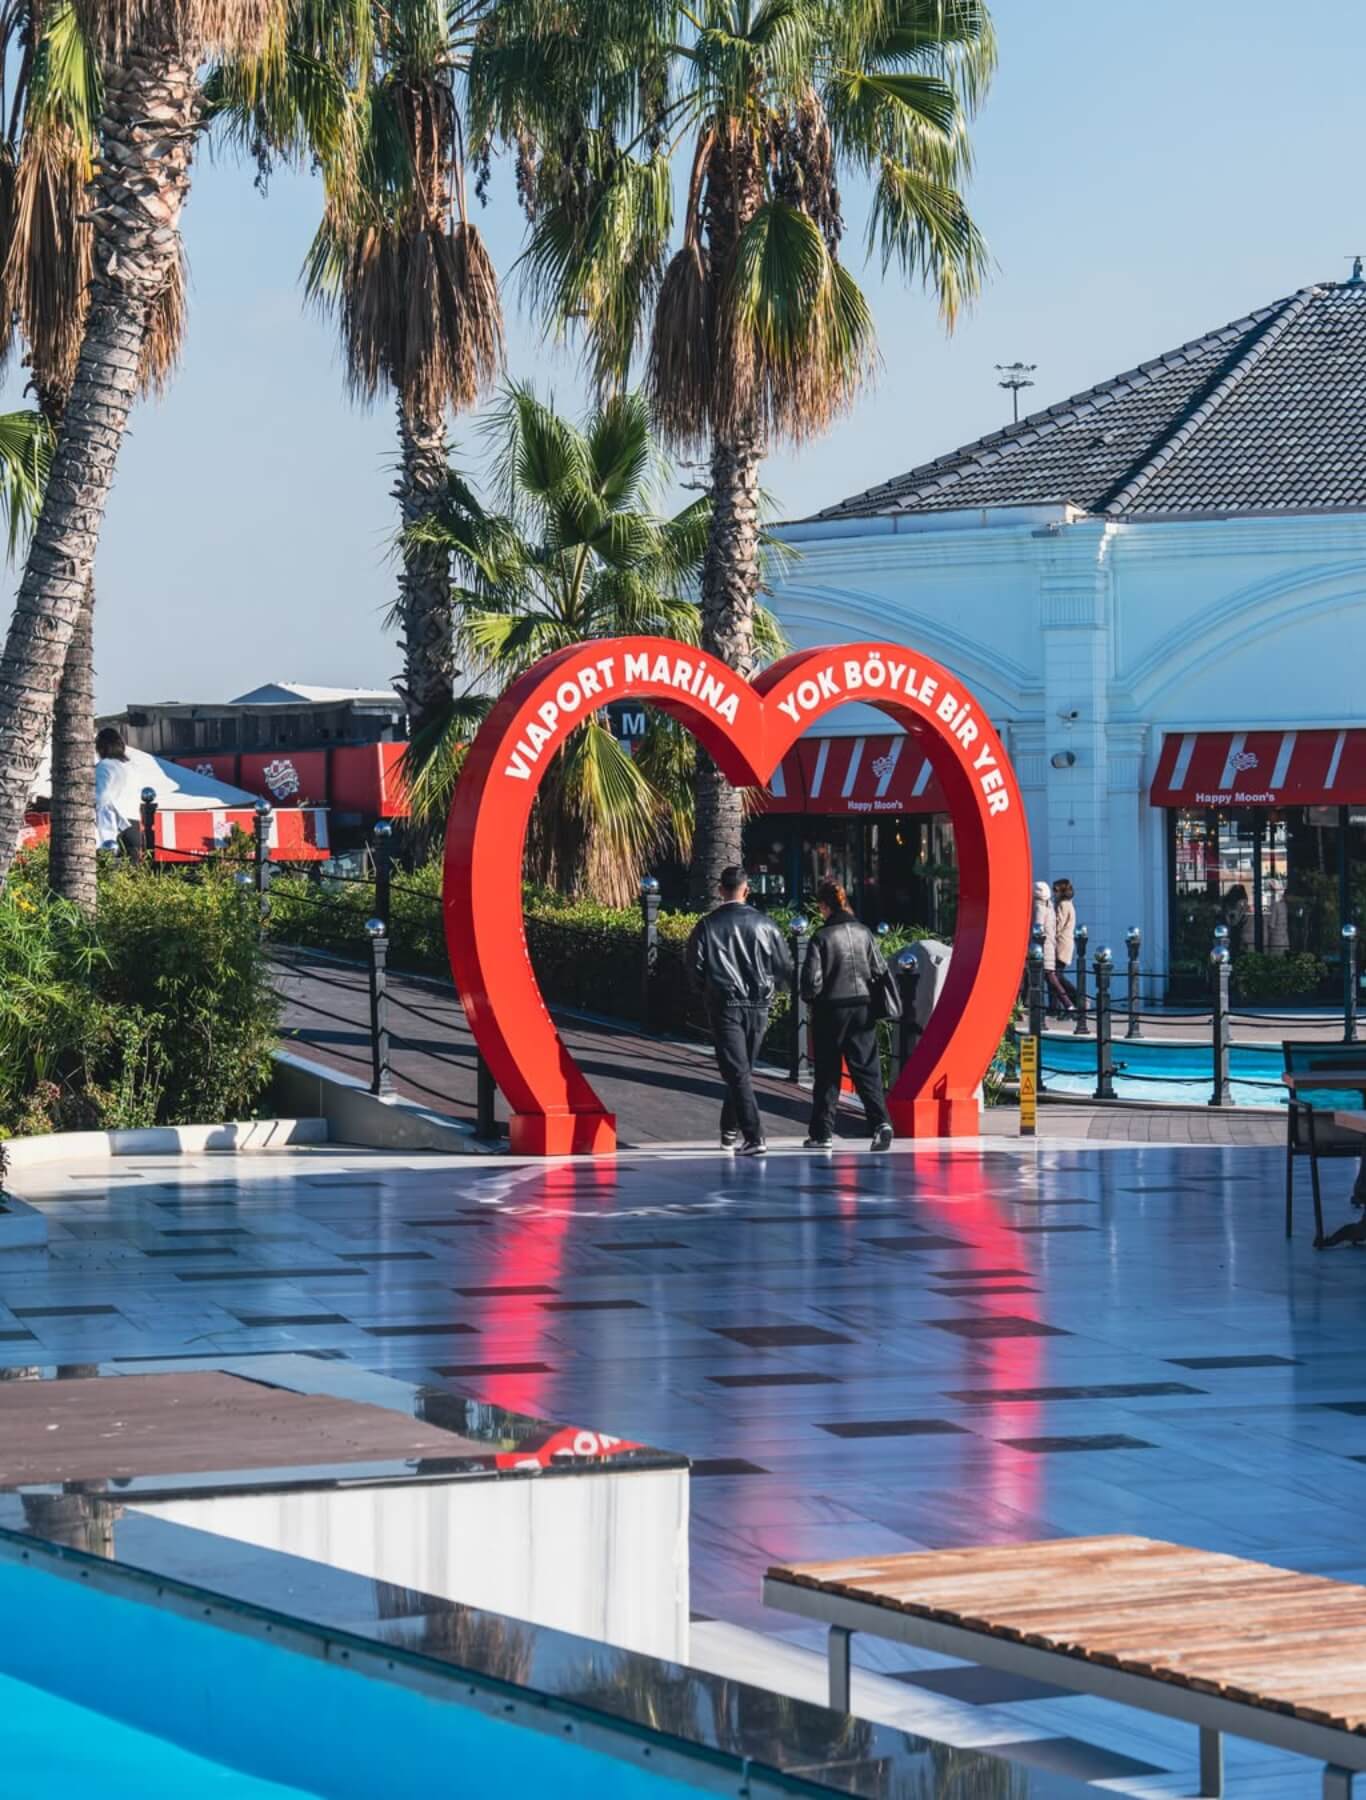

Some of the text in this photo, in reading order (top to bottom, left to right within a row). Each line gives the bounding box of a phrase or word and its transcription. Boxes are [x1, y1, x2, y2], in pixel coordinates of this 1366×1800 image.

[504, 652, 740, 780] VIAPORT MARİNA
[777, 651, 1010, 817] YOK BÖYLE BİR YER
[847, 800, 903, 811] Happy Moon's
[1195, 791, 1276, 805] Happy Moon's
